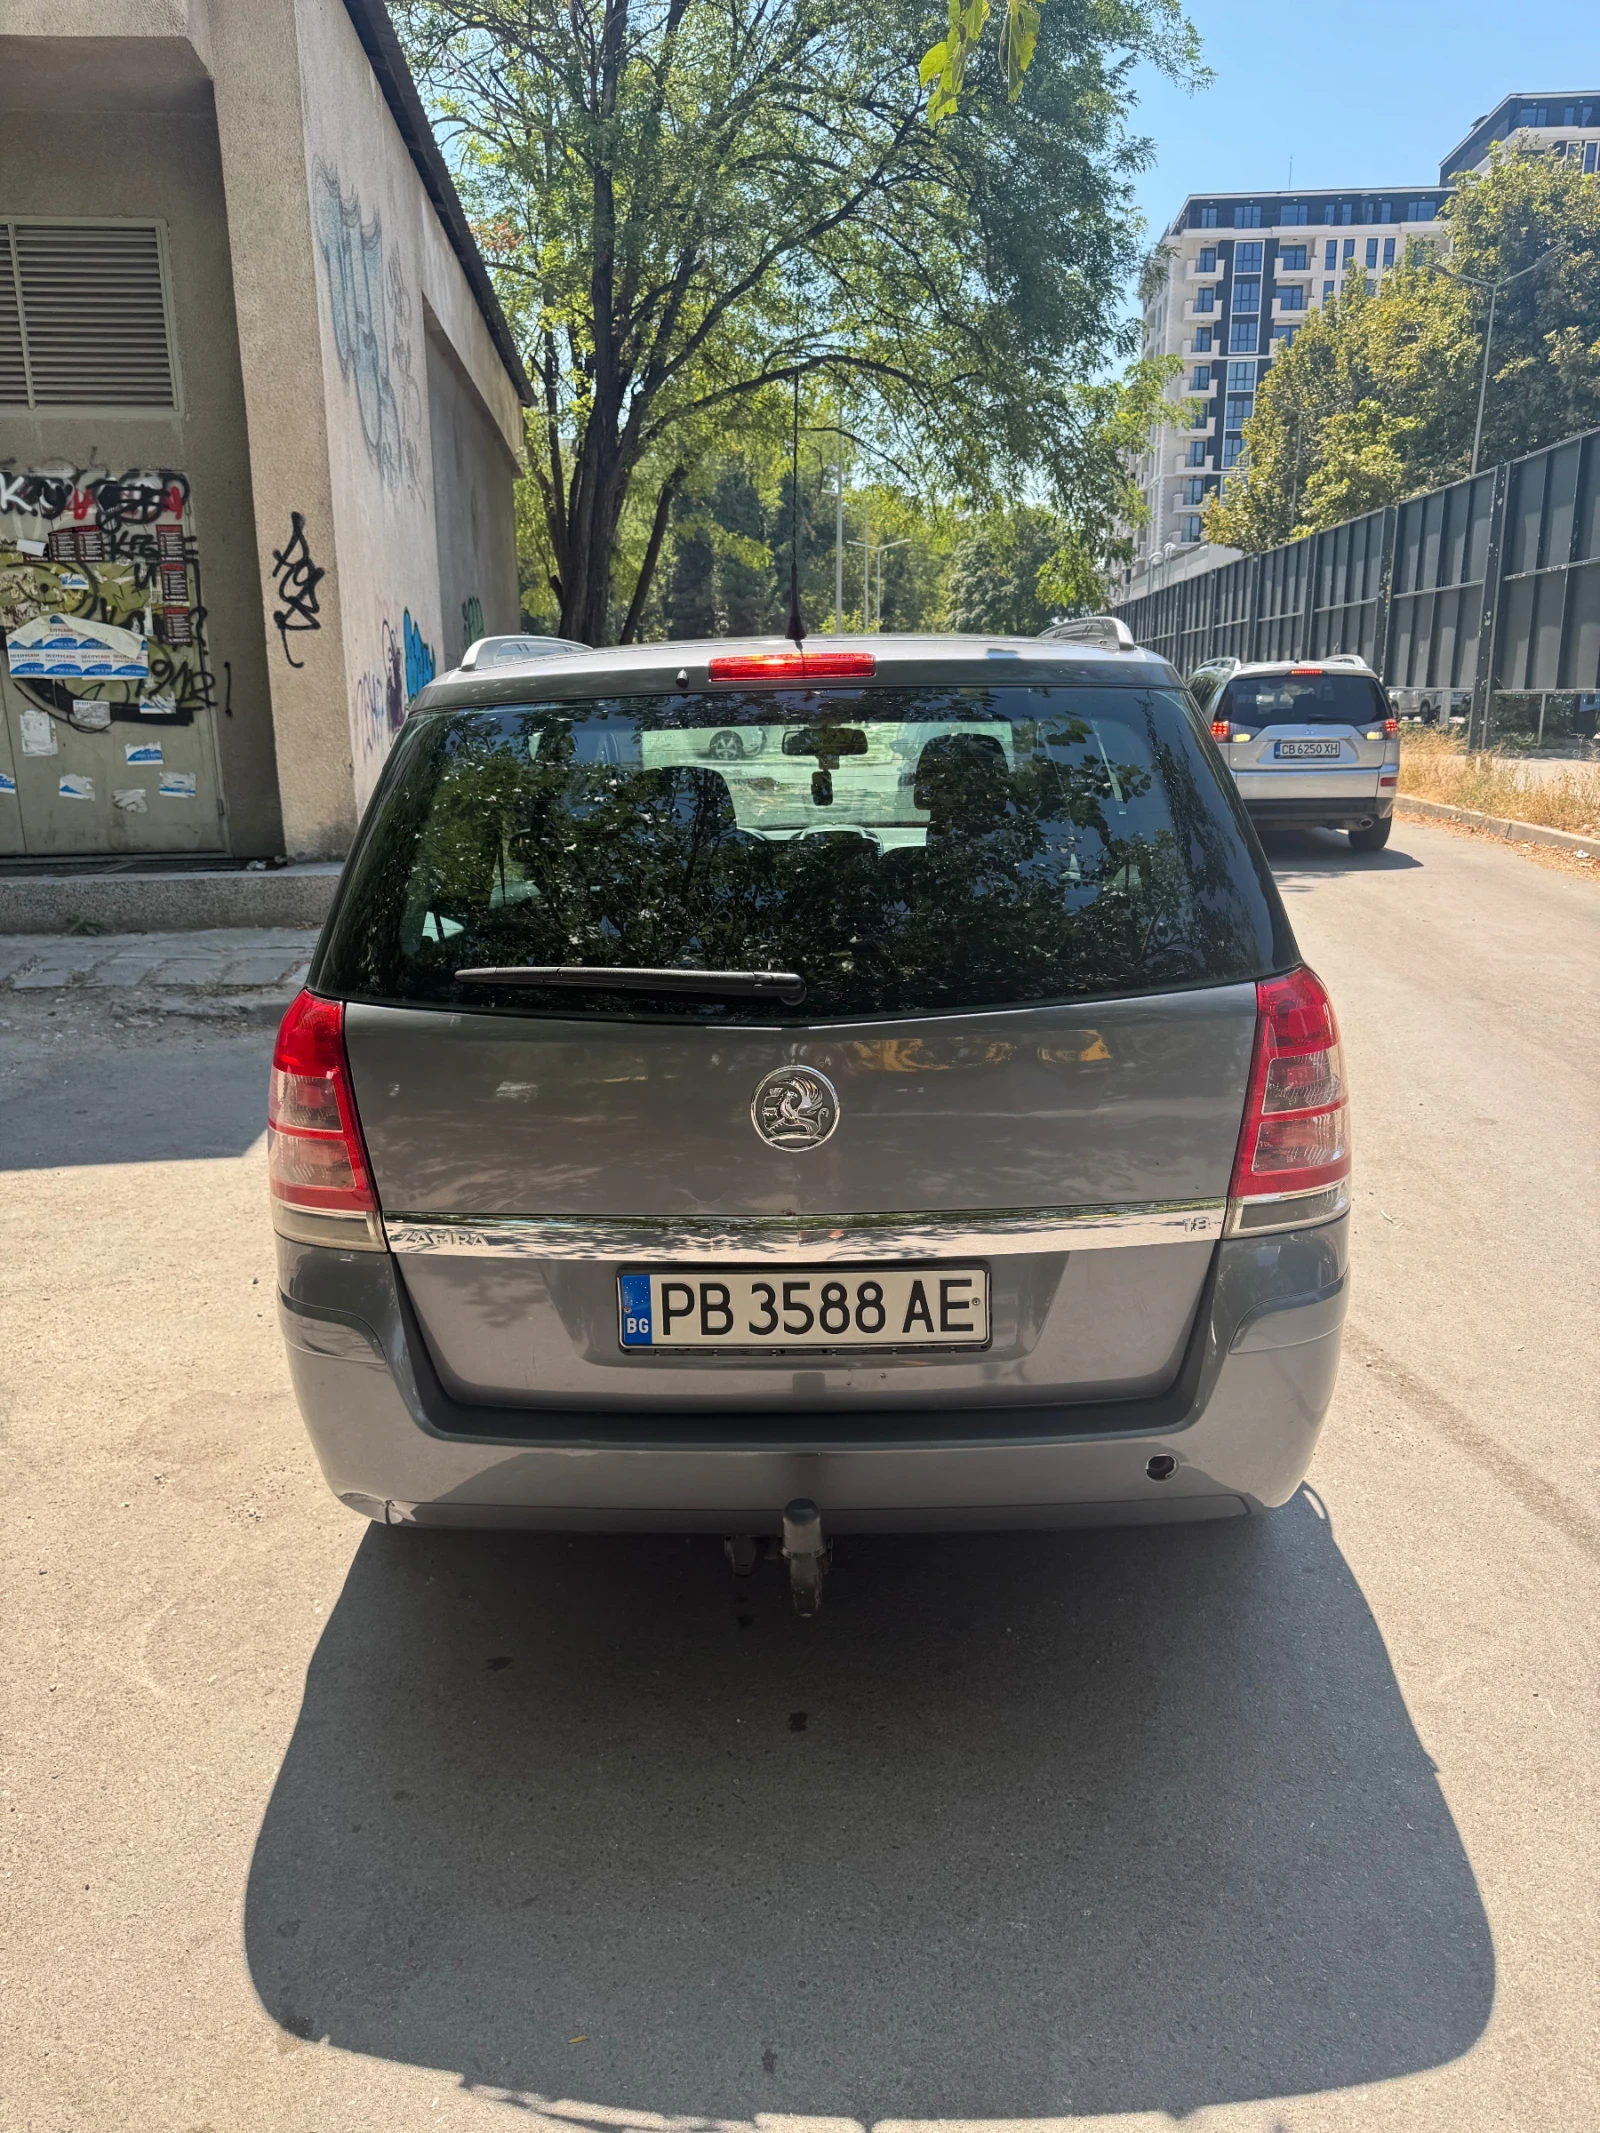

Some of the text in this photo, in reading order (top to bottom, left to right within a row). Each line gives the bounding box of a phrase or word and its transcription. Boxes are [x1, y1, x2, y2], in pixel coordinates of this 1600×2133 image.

[1282, 743, 1338, 755] CB 6250 XH
[400, 1228, 491, 1246] ZAFIRA
[661, 1278, 975, 1335] PB 3588 AE
[626, 1318, 649, 1334] BG
